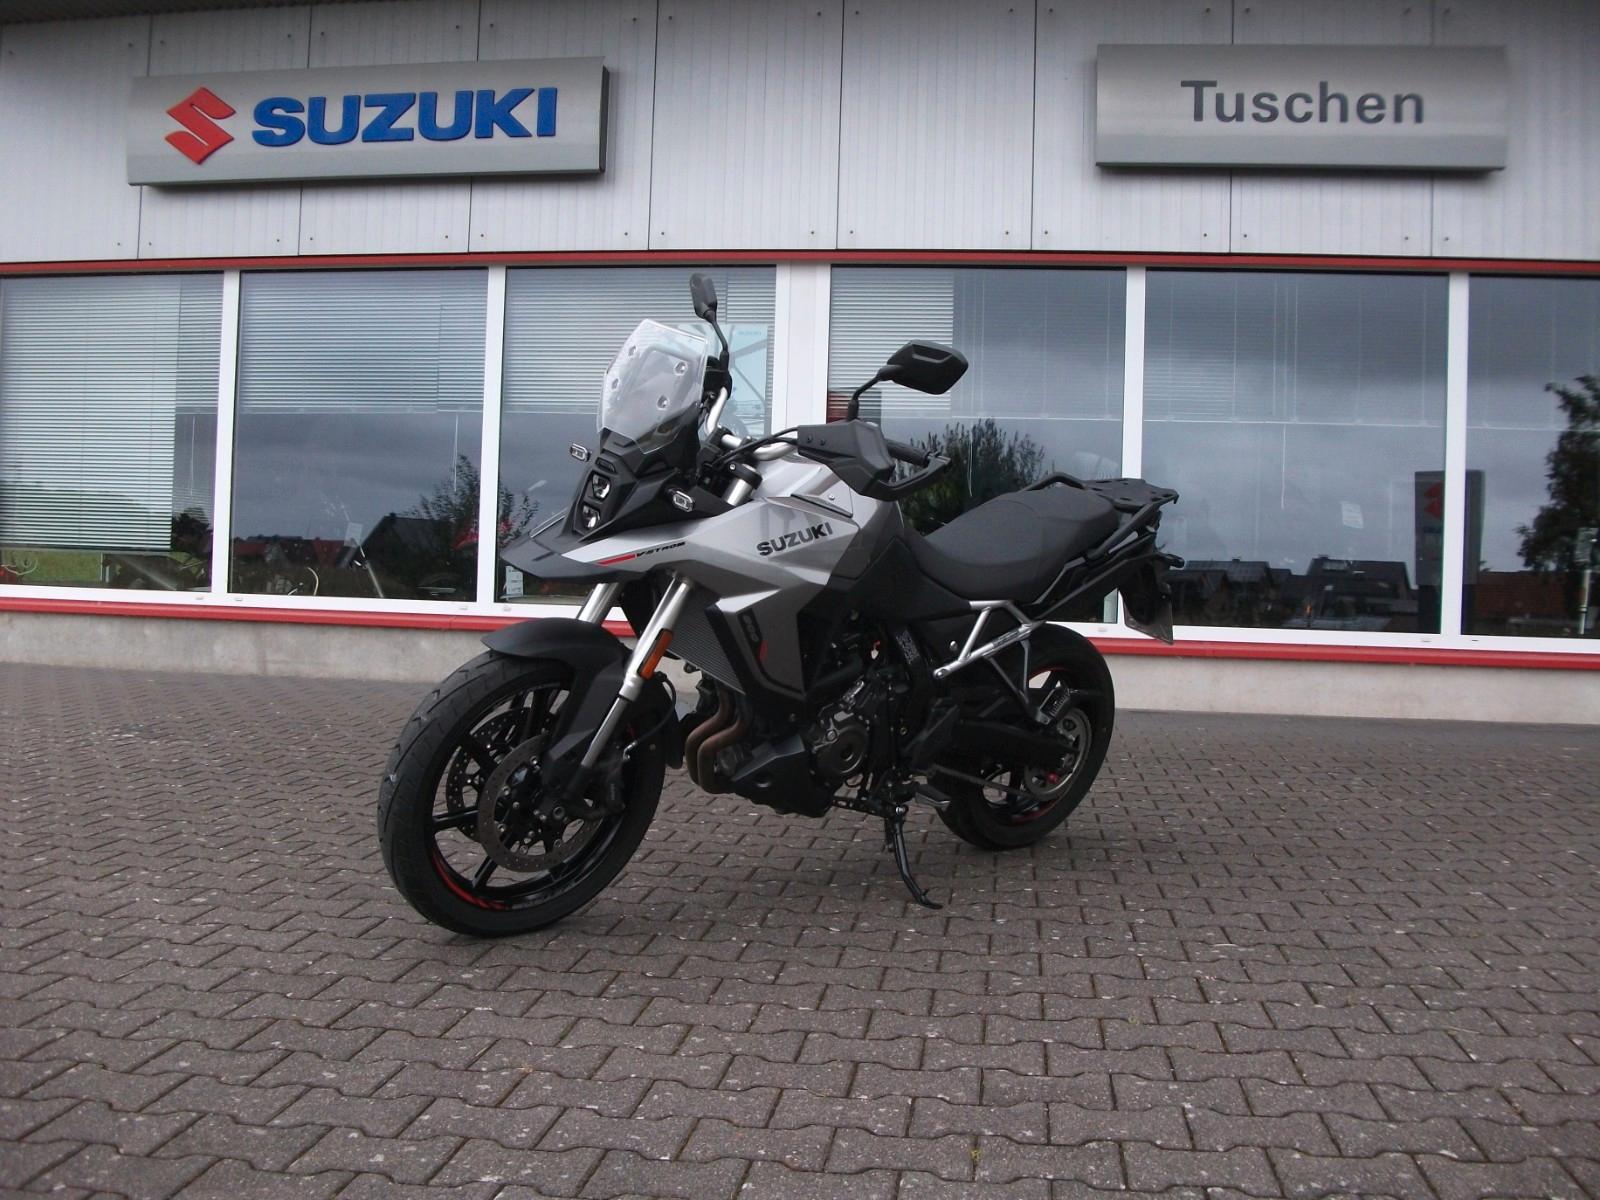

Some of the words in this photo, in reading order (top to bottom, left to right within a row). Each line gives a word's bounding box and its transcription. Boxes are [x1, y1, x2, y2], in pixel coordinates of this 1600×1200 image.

[252, 87, 558, 147] SUZUKI
[1180, 80, 1425, 124] Tuschen
[756, 521, 834, 557] SUZUKI
